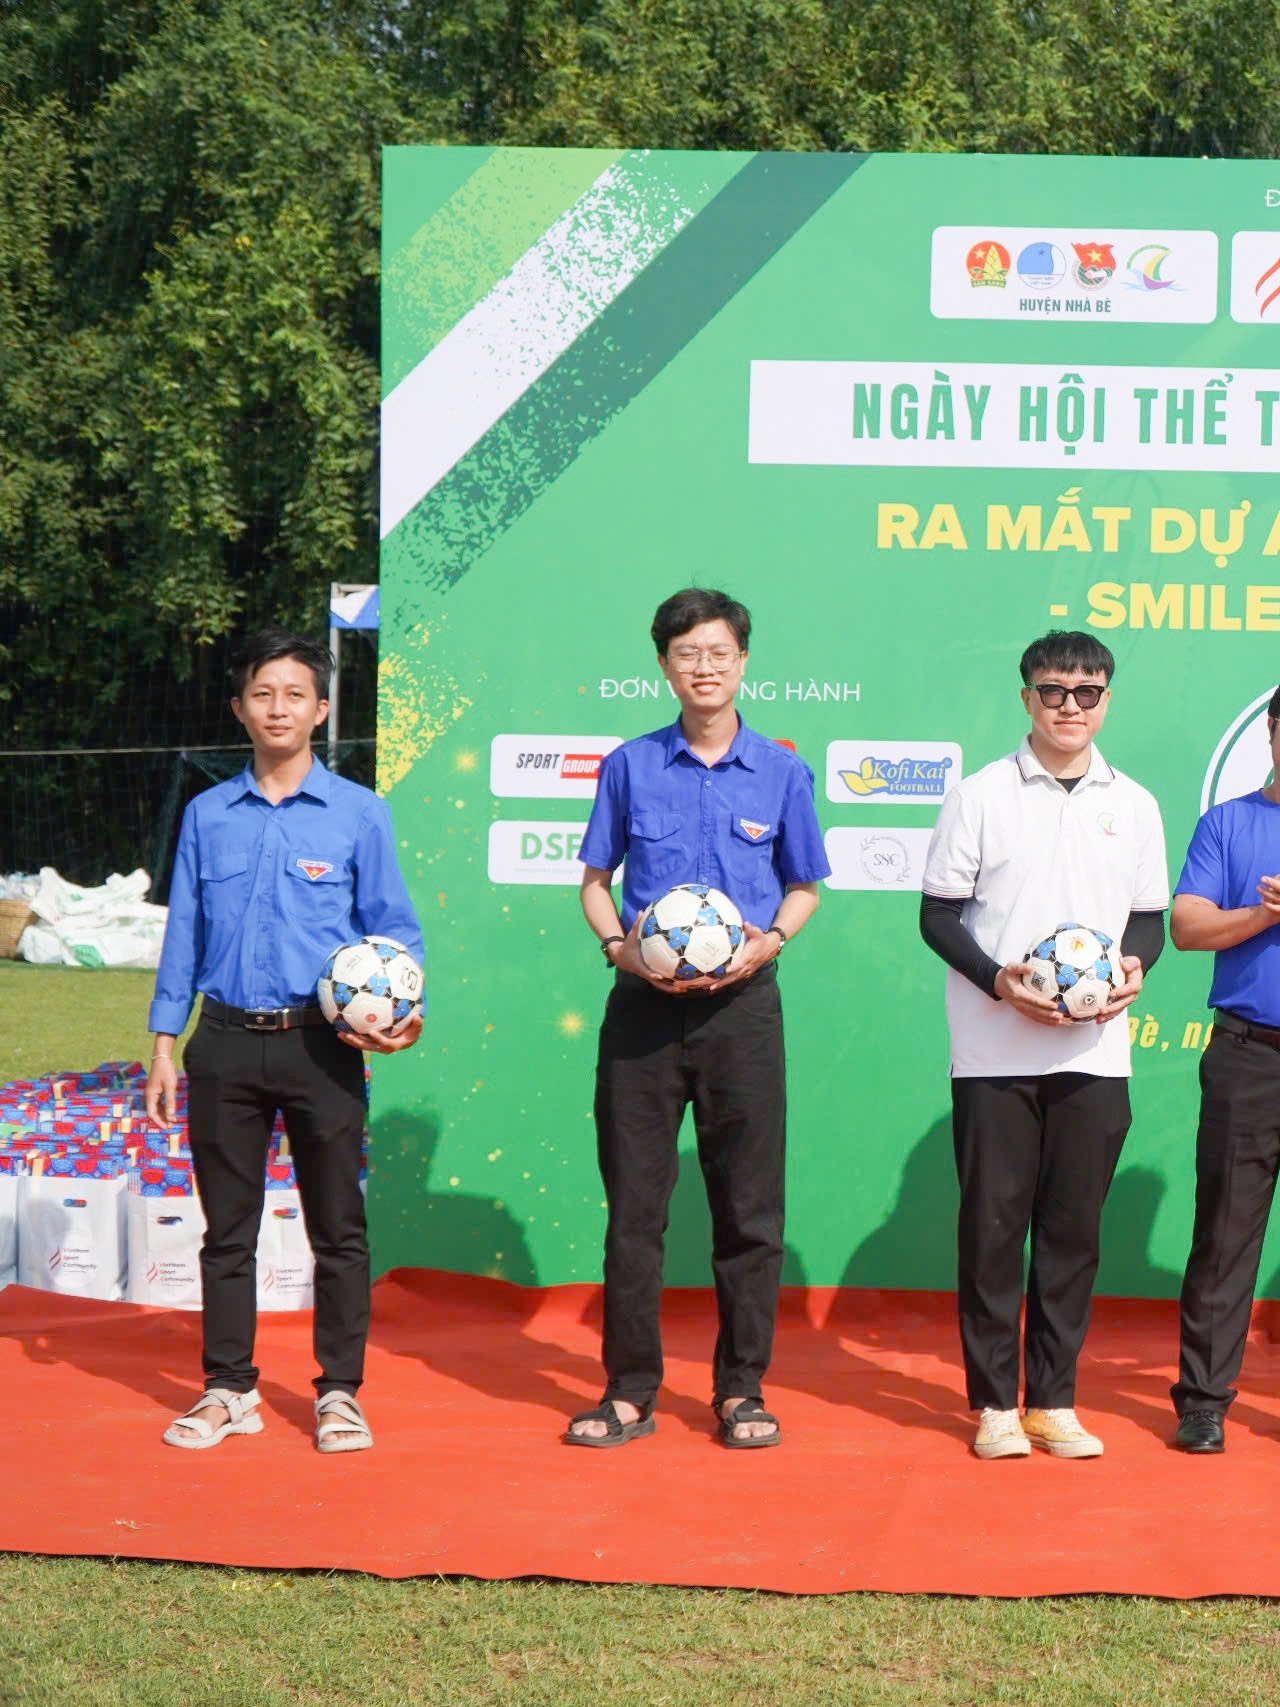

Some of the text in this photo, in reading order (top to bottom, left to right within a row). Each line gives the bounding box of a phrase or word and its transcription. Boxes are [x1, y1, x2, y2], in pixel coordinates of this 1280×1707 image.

[1019, 296, 1112, 315] HUYỆN NHÀ BÈ
[852, 370, 992, 441] NGÀY
[1019, 373, 1106, 455] HỘI
[1134, 373, 1234, 445] THỂ
[876, 502, 968, 550] RA
[986, 486, 1131, 553] MẮT
[1150, 500, 1251, 568] DỰ
[599, 676, 659, 699] ĐƠN
[785, 678, 861, 701] HÀNH
[516, 753, 600, 773] SPORT GROUP
[872, 761, 944, 784] Kofi Kai
[889, 783, 943, 793] FOOTBALL
